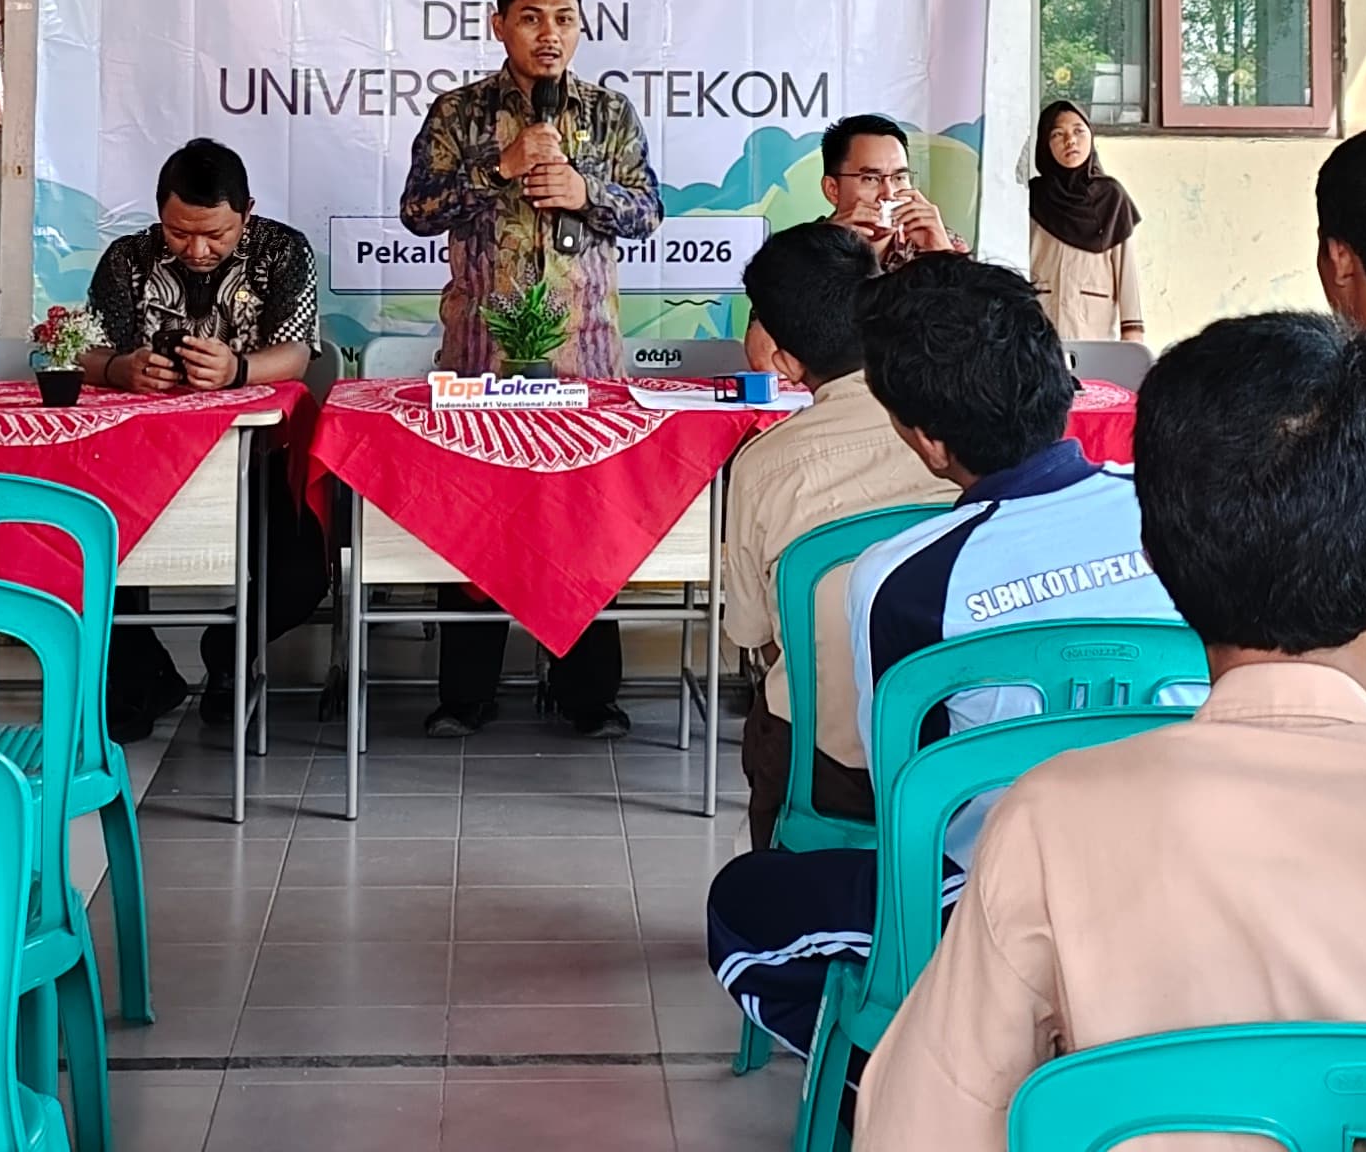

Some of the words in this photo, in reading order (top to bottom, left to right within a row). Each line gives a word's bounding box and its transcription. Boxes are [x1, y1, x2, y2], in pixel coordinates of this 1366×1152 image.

[665, 240, 732, 263] 2026
[434, 375, 585, 400] TopLoker.com
[435, 401, 481, 409] Indonesia
[496, 400, 544, 408] Vocational
[547, 400, 563, 408] Job
[565, 399, 584, 407] Site
[966, 579, 1033, 622] SLBN
[1028, 564, 1094, 603] KOTA
[1090, 551, 1155, 588] PEKA
